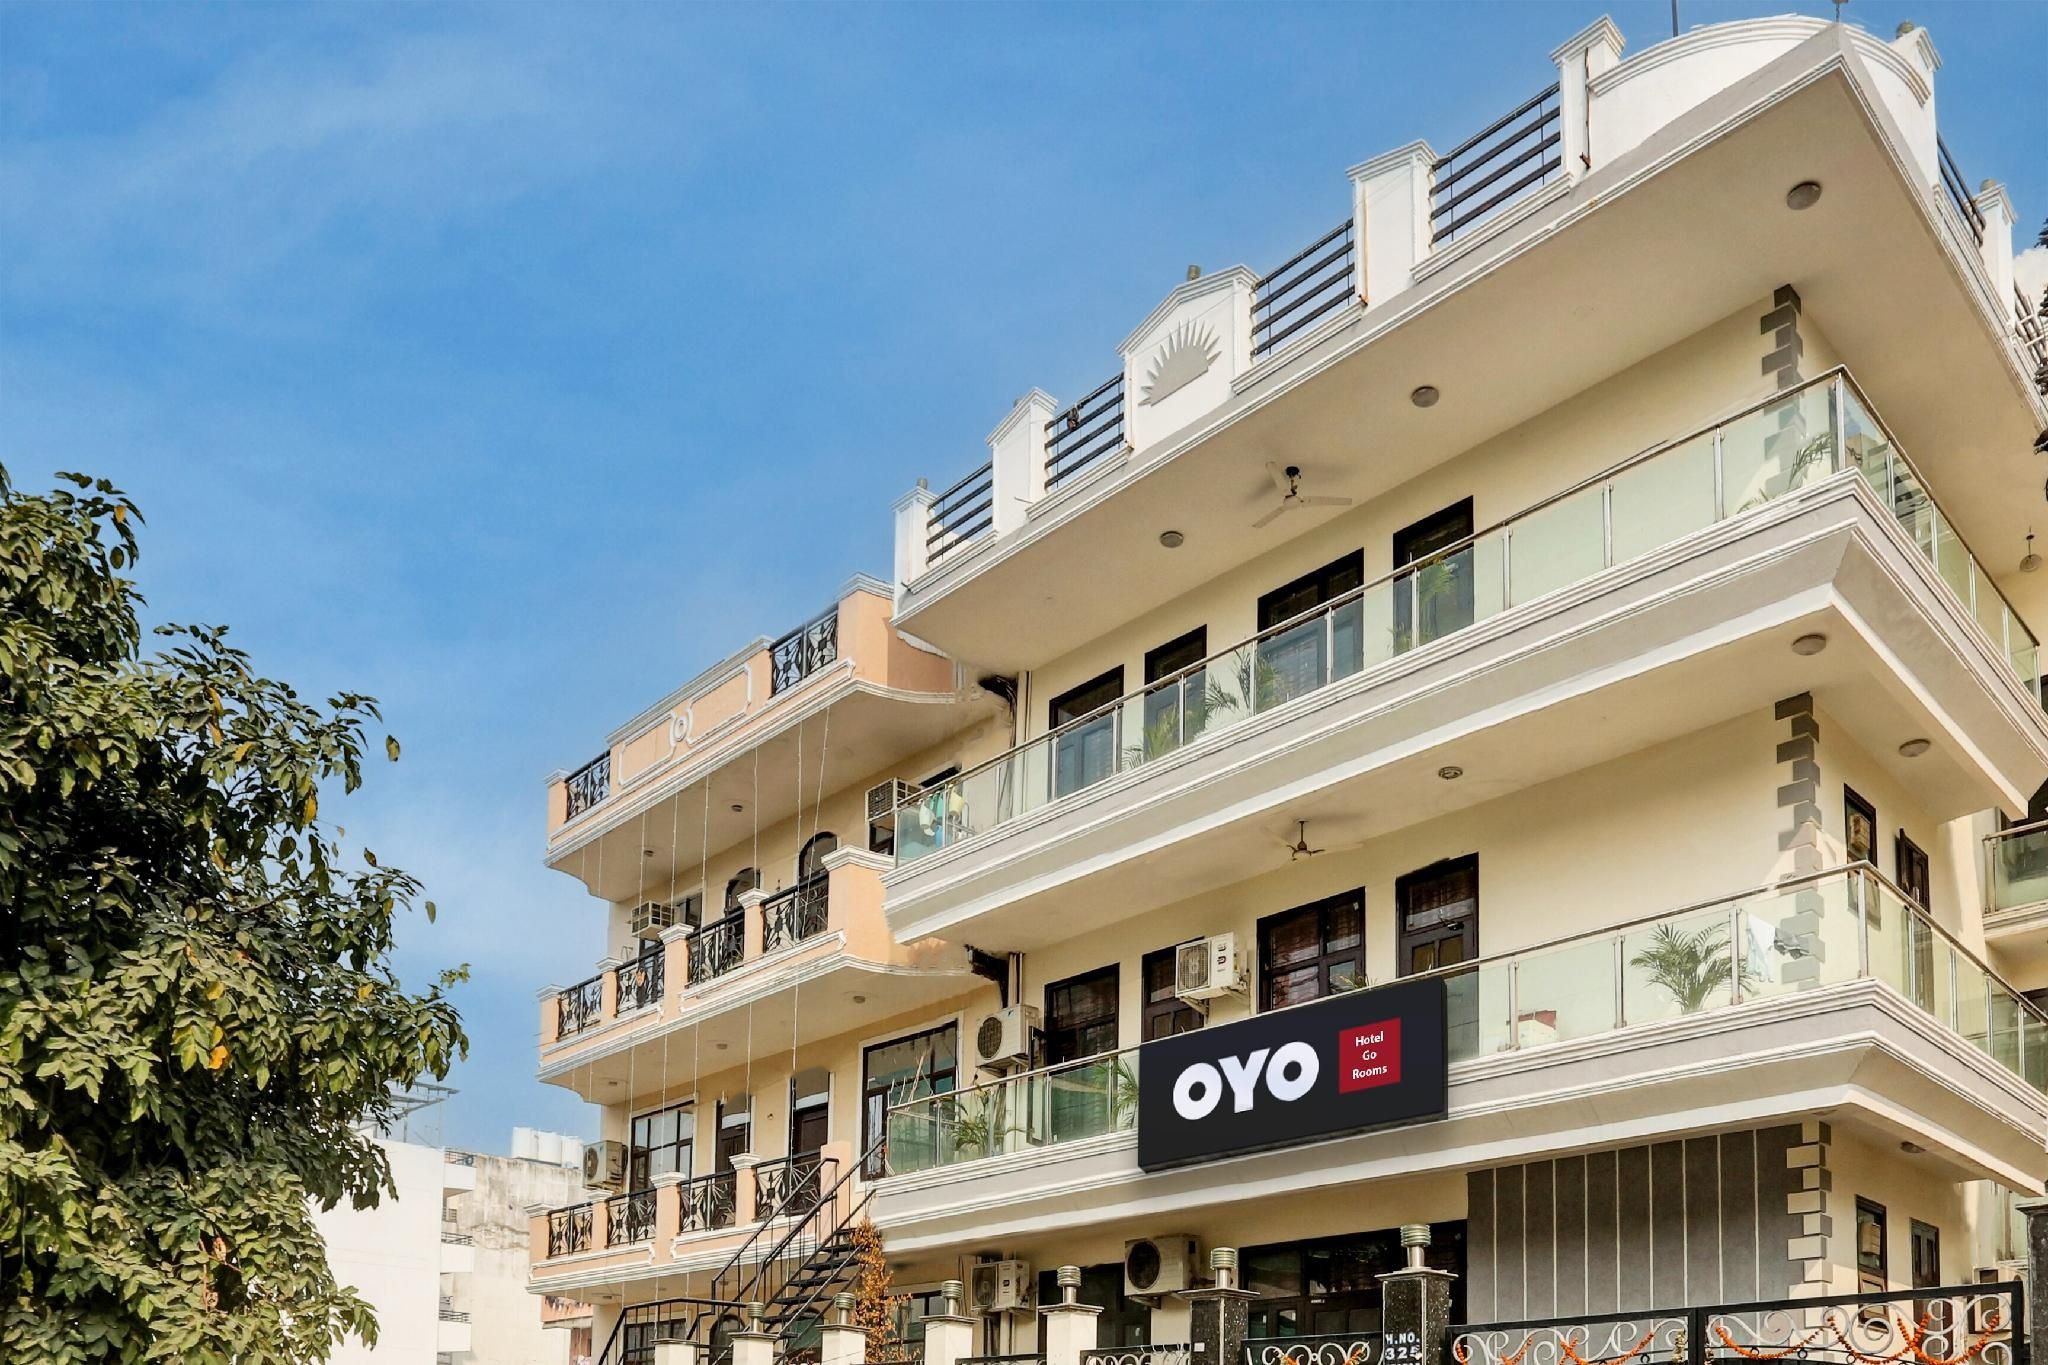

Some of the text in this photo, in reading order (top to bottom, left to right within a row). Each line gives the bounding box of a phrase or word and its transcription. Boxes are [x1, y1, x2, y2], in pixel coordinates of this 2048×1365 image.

[1355, 1030, 1384, 1047] Hotel
[1362, 1049, 1377, 1061] Go
[1352, 1065, 1388, 1080] Rooms
[1173, 1041, 1320, 1121] OYO
[1385, 1332, 1420, 1345] H.NO.
